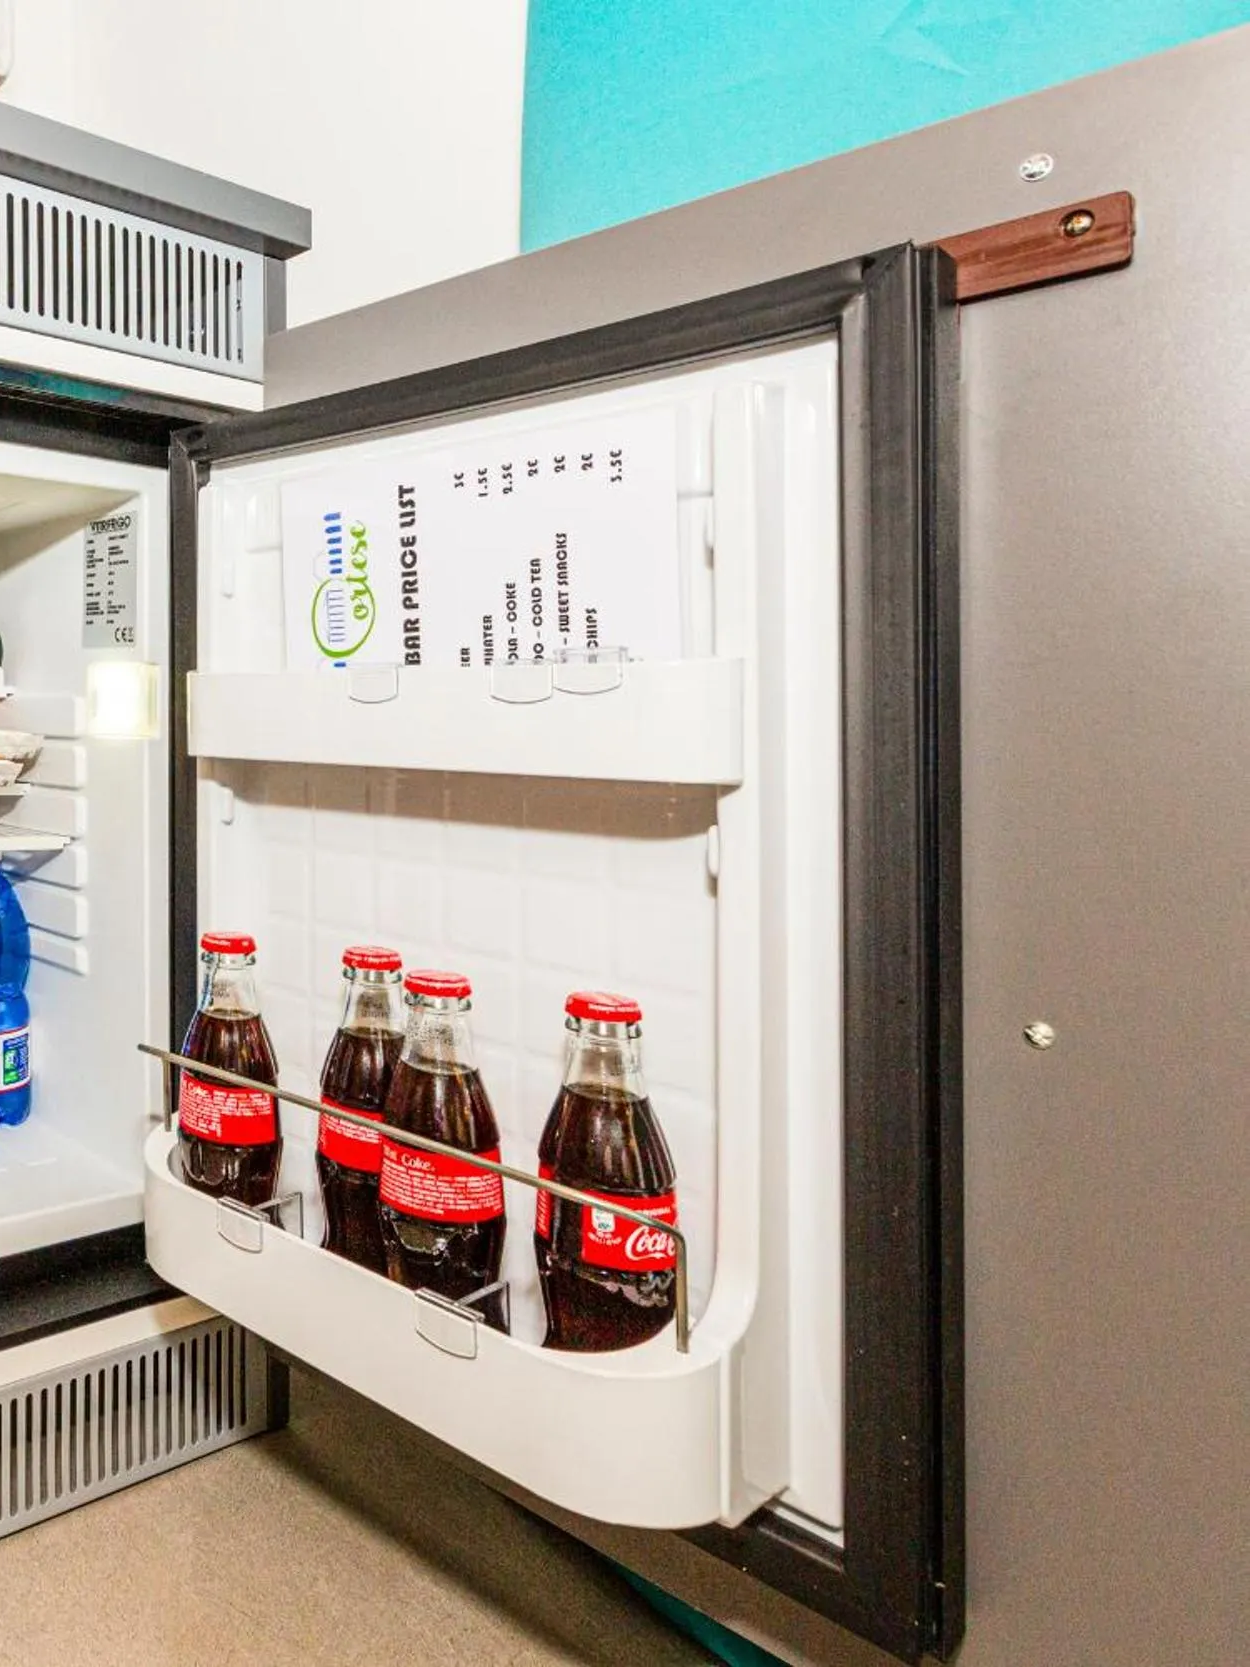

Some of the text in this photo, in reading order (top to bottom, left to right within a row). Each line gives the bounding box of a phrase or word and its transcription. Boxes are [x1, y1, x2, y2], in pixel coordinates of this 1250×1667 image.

[527, 459, 538, 477] 2€
[554, 455, 565, 473] 2€
[581, 453, 593, 471] 2€
[478, 467, 488, 497] 1.5€
[501, 462, 513, 494] 2.5€
[530, 558, 541, 583] TEA
[556, 533, 568, 586] SNACKS
[398, 485, 421, 666] BAR PRICE LIST
[506, 582, 517, 622] COKE
[531, 587, 543, 627] COLD
[558, 590, 570, 633] SWEET
[460, 647, 470, 667] ER
